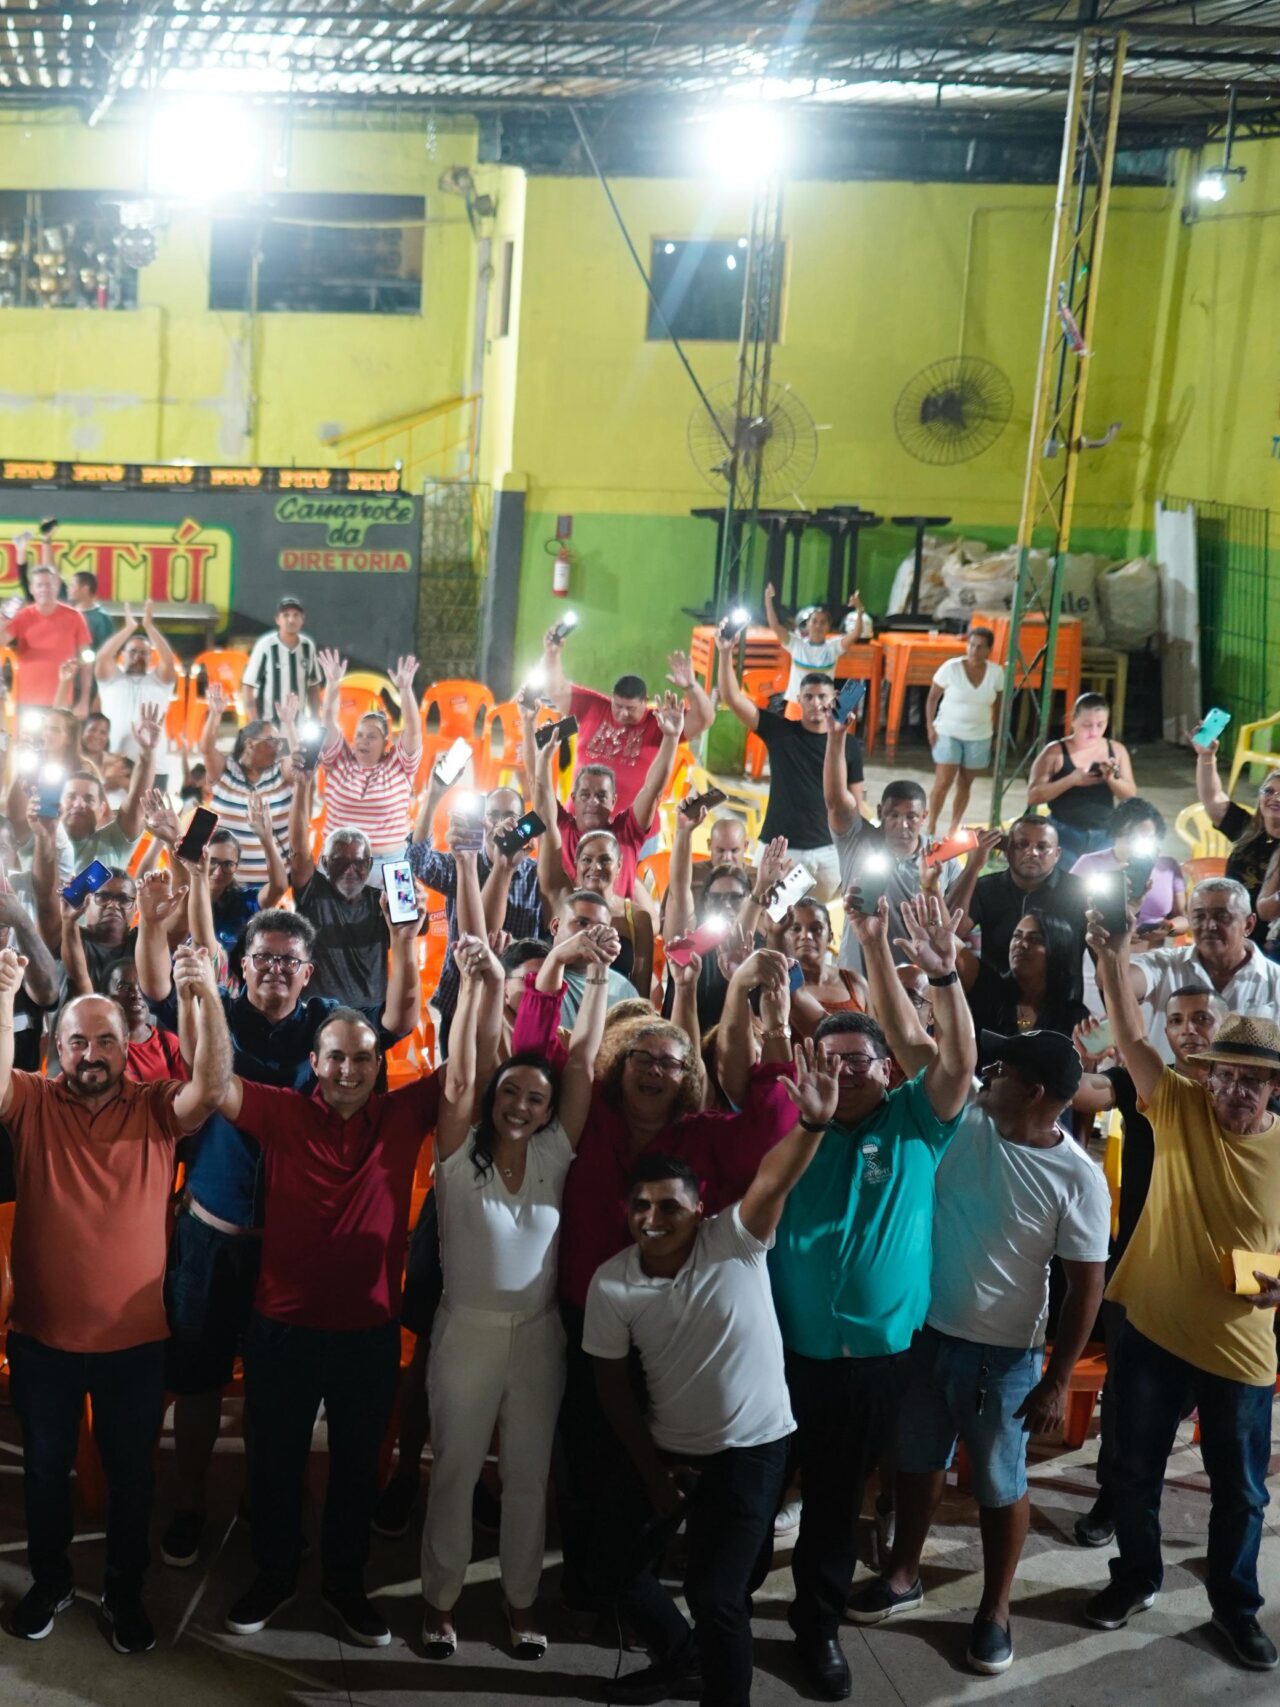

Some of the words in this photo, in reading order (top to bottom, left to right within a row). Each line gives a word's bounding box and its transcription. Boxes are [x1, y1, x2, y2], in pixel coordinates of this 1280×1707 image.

[278, 497, 411, 522] Camarote
[328, 519, 361, 545] da
[283, 551, 408, 571] DIRETORIA
